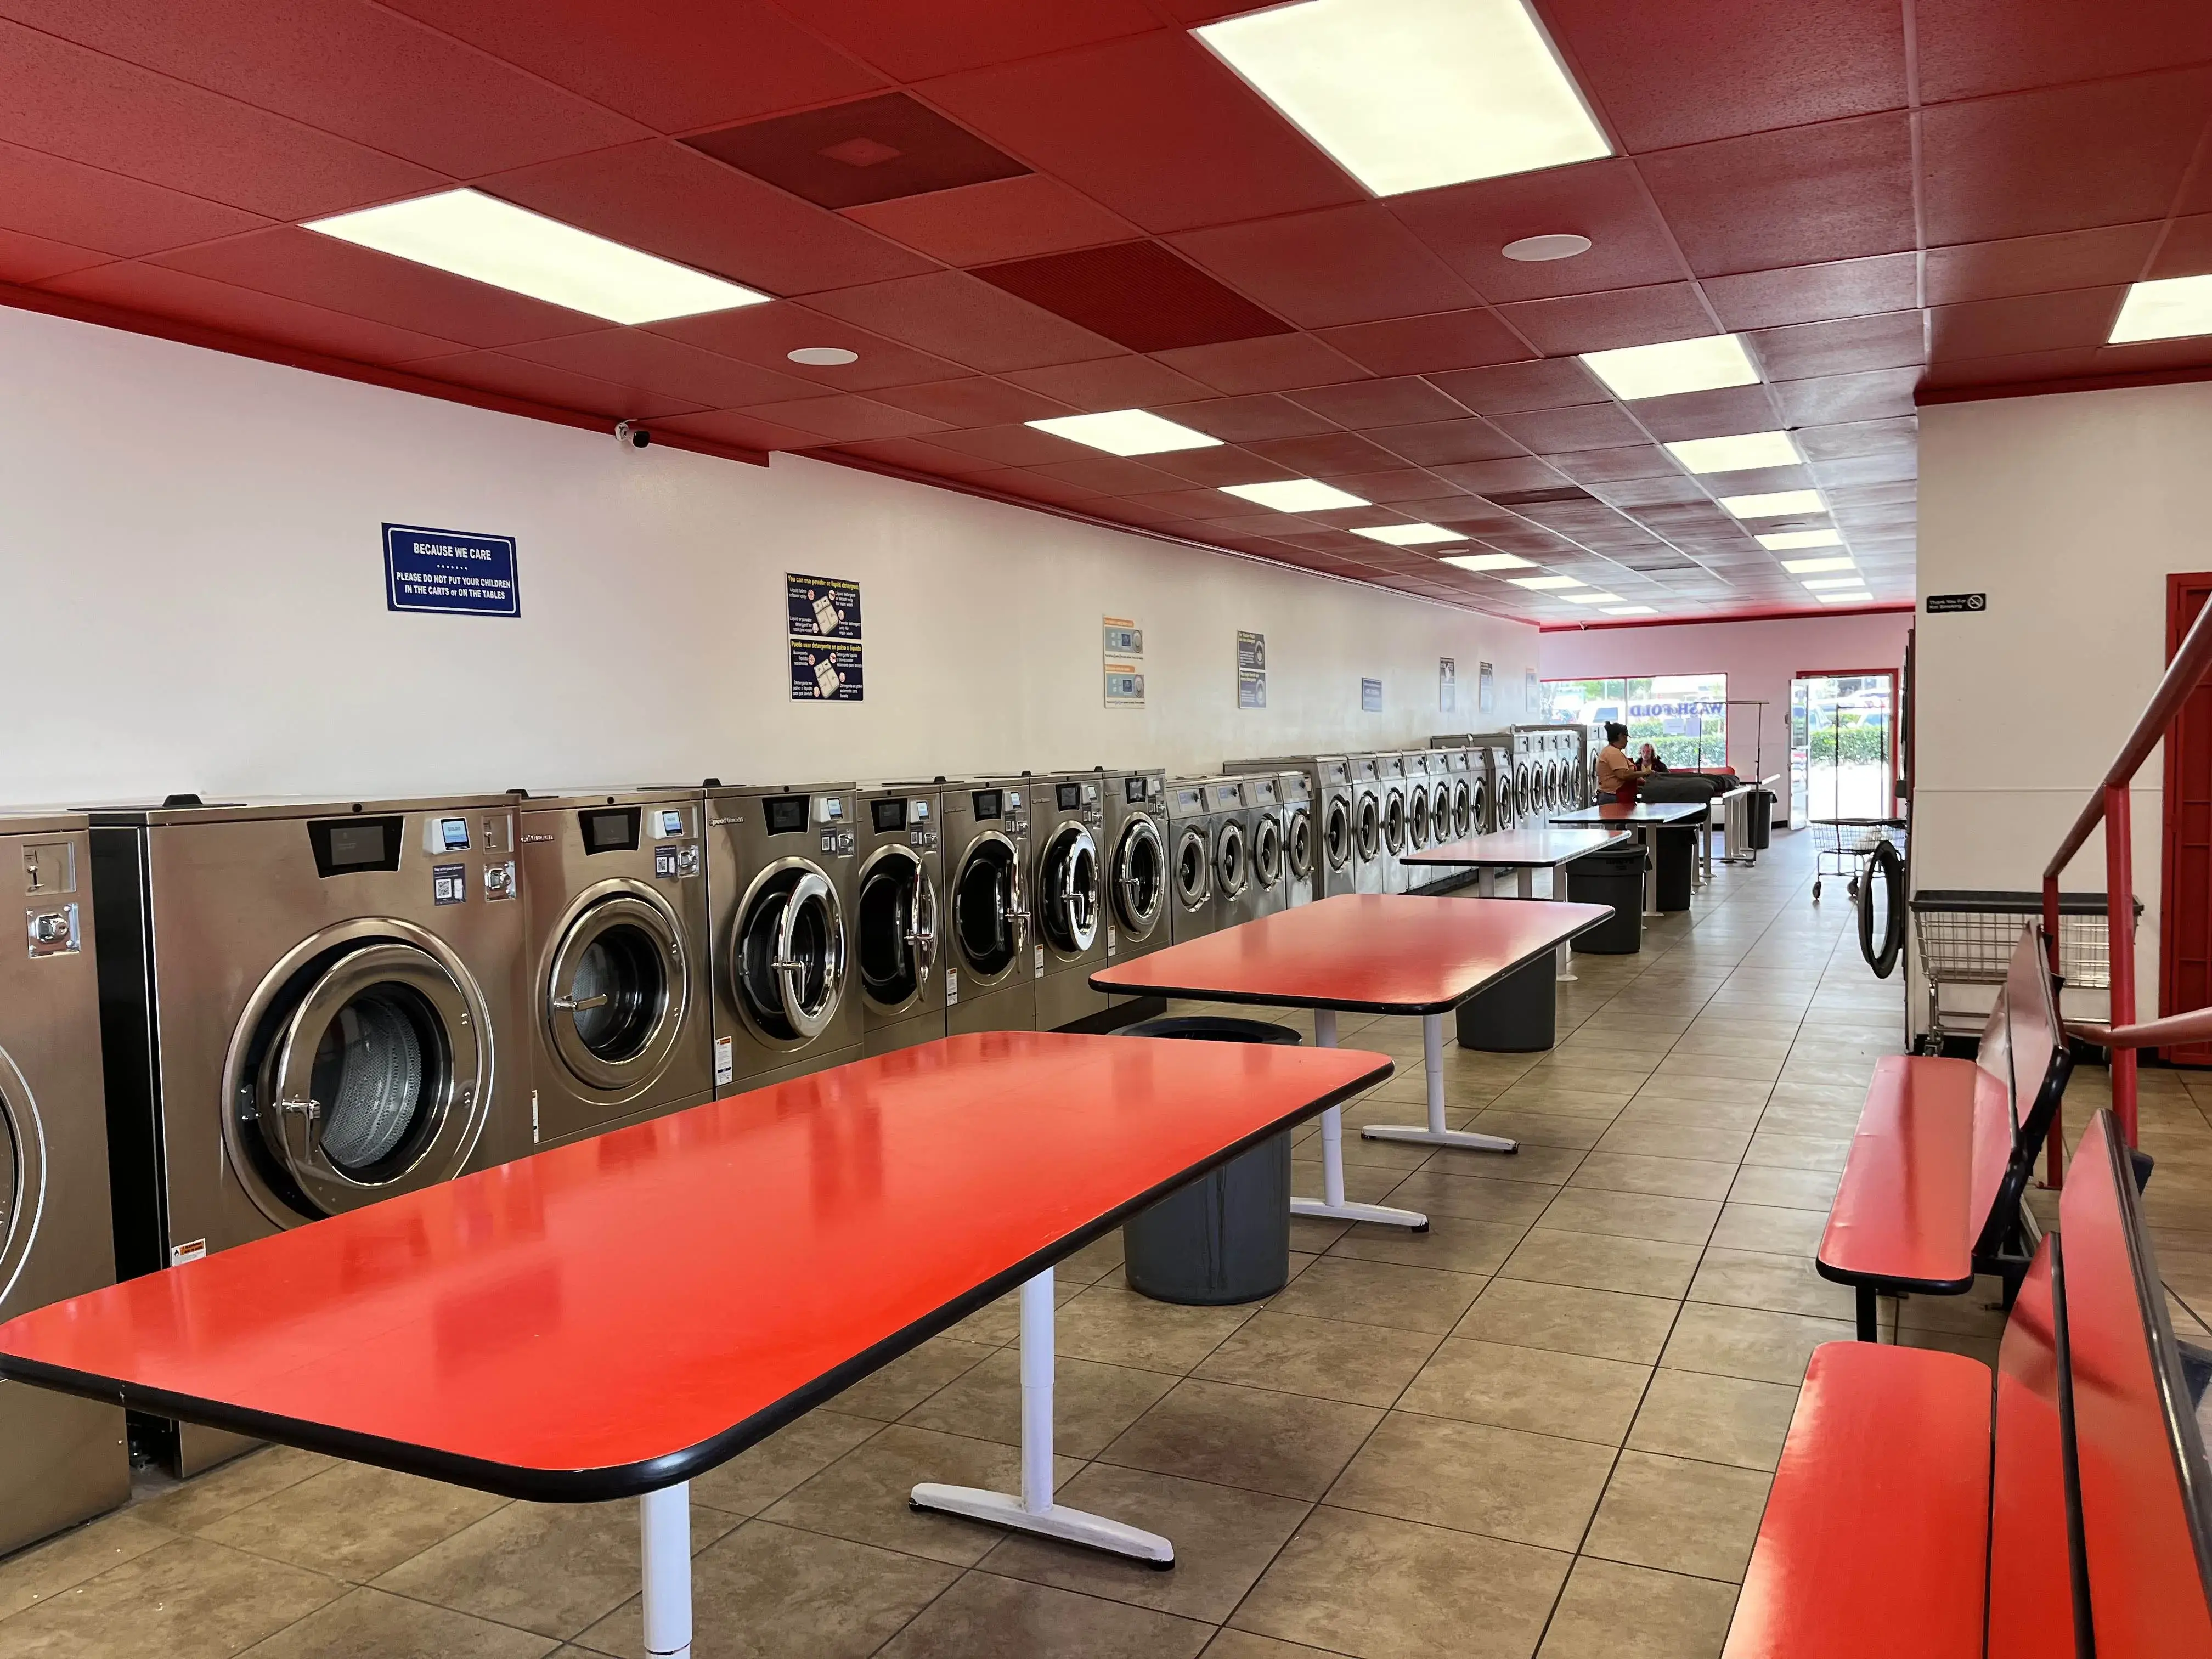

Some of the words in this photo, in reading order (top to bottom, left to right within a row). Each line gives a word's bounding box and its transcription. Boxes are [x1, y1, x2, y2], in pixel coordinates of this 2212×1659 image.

[413, 543, 453, 557] BECAUSE
[454, 547, 468, 558] WE
[470, 548, 492, 561] CARE
[396, 572, 421, 582] PLEASE
[423, 574, 432, 583] DO
[434, 574, 447, 584] NOT
[448, 576, 461, 585] PUT
[462, 577, 479, 586] YOUR
[481, 578, 511, 589] CHILDREN
[404, 584, 412, 593] IN
[414, 585, 427, 594] THE
[428, 586, 449, 596] CARTS
[458, 589, 467, 597] ON
[469, 589, 481, 598] THE
[482, 590, 505, 599] TABLES
[812, 642, 831, 651] detergente
